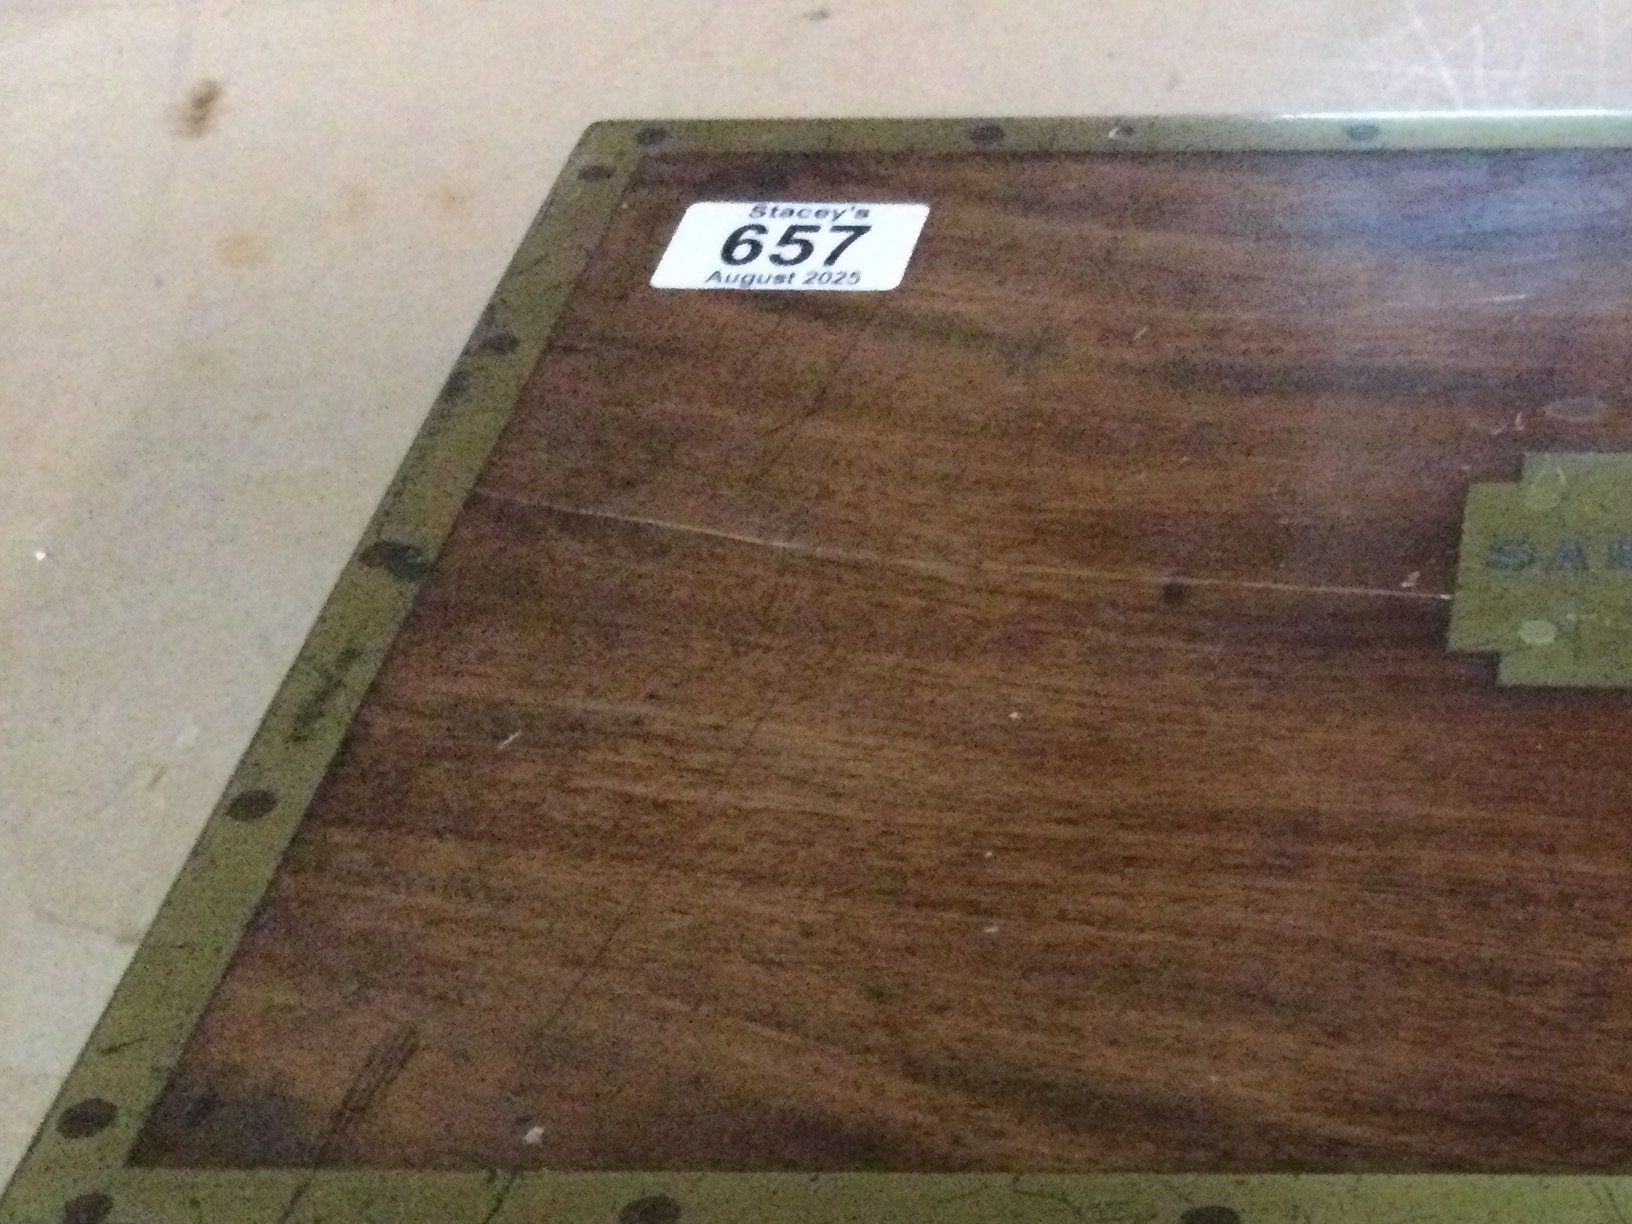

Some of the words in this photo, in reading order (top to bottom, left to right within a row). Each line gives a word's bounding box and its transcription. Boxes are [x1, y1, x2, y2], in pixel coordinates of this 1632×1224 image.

[748, 204, 870, 222] Stacey's
[720, 223, 872, 267] 657
[704, 270, 796, 288] August
[802, 270, 862, 285] 2025
